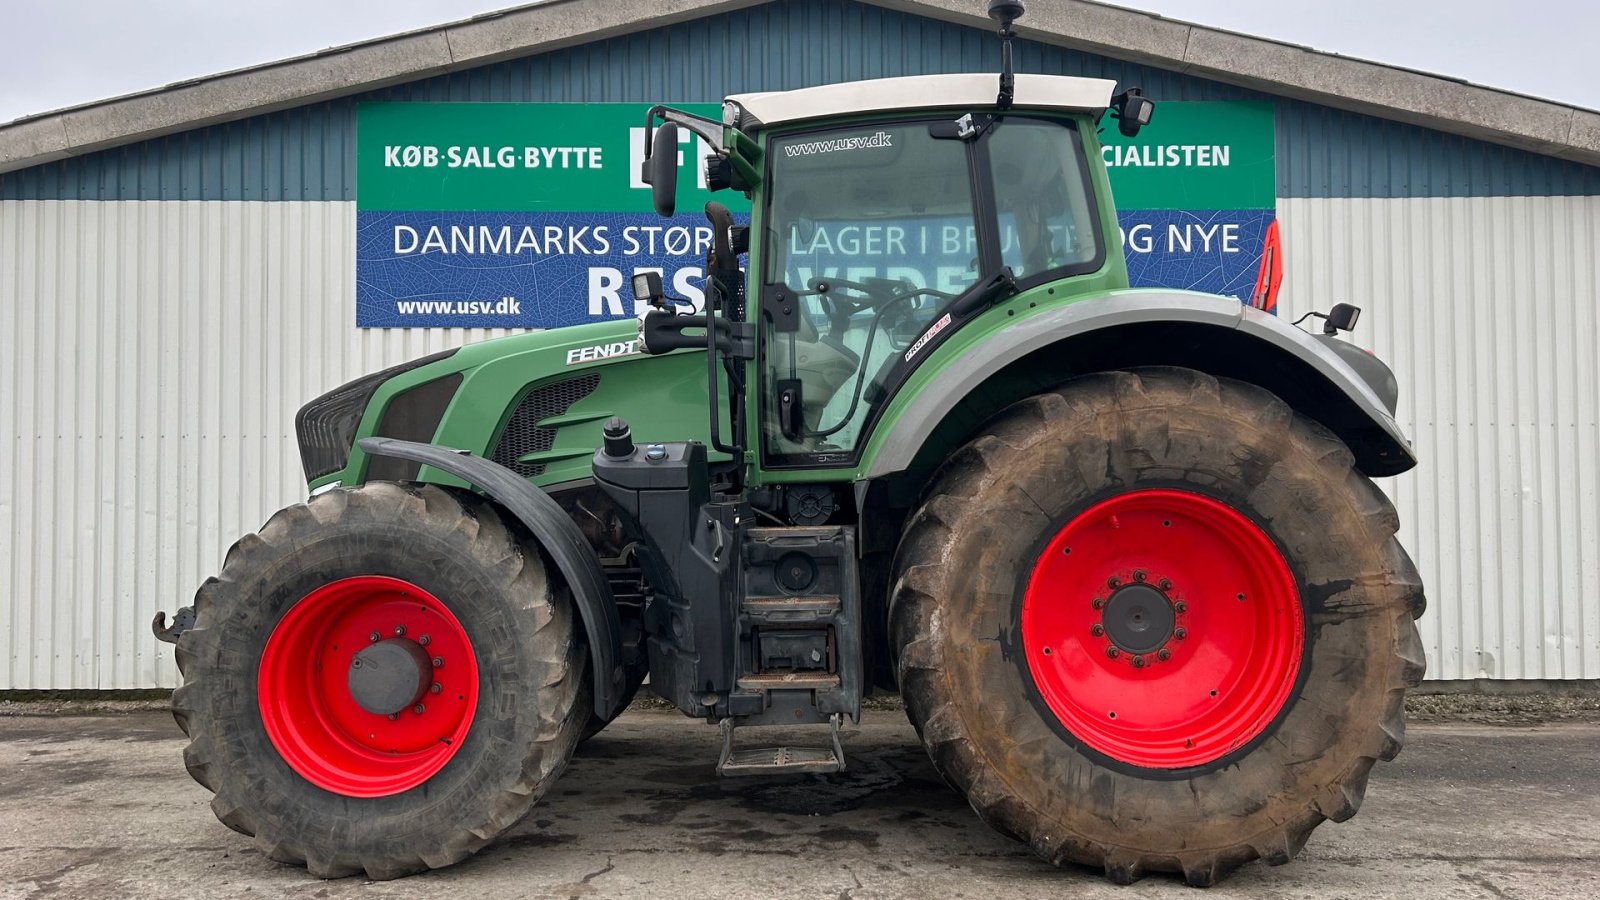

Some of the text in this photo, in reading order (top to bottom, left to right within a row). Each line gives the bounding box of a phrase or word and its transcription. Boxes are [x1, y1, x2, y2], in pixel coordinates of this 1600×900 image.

[785, 131, 892, 157] www.usv.dk
[1100, 145, 1230, 167] CIALISTEN
[394, 225, 610, 255] DANMARKS
[623, 225, 714, 255] STØR
[791, 226, 906, 255] LAGER
[920, 226, 926, 254] I
[1168, 224, 1239, 253] NYE
[397, 297, 520, 314] www.usv.dk
[566, 340, 641, 365] FENDT
